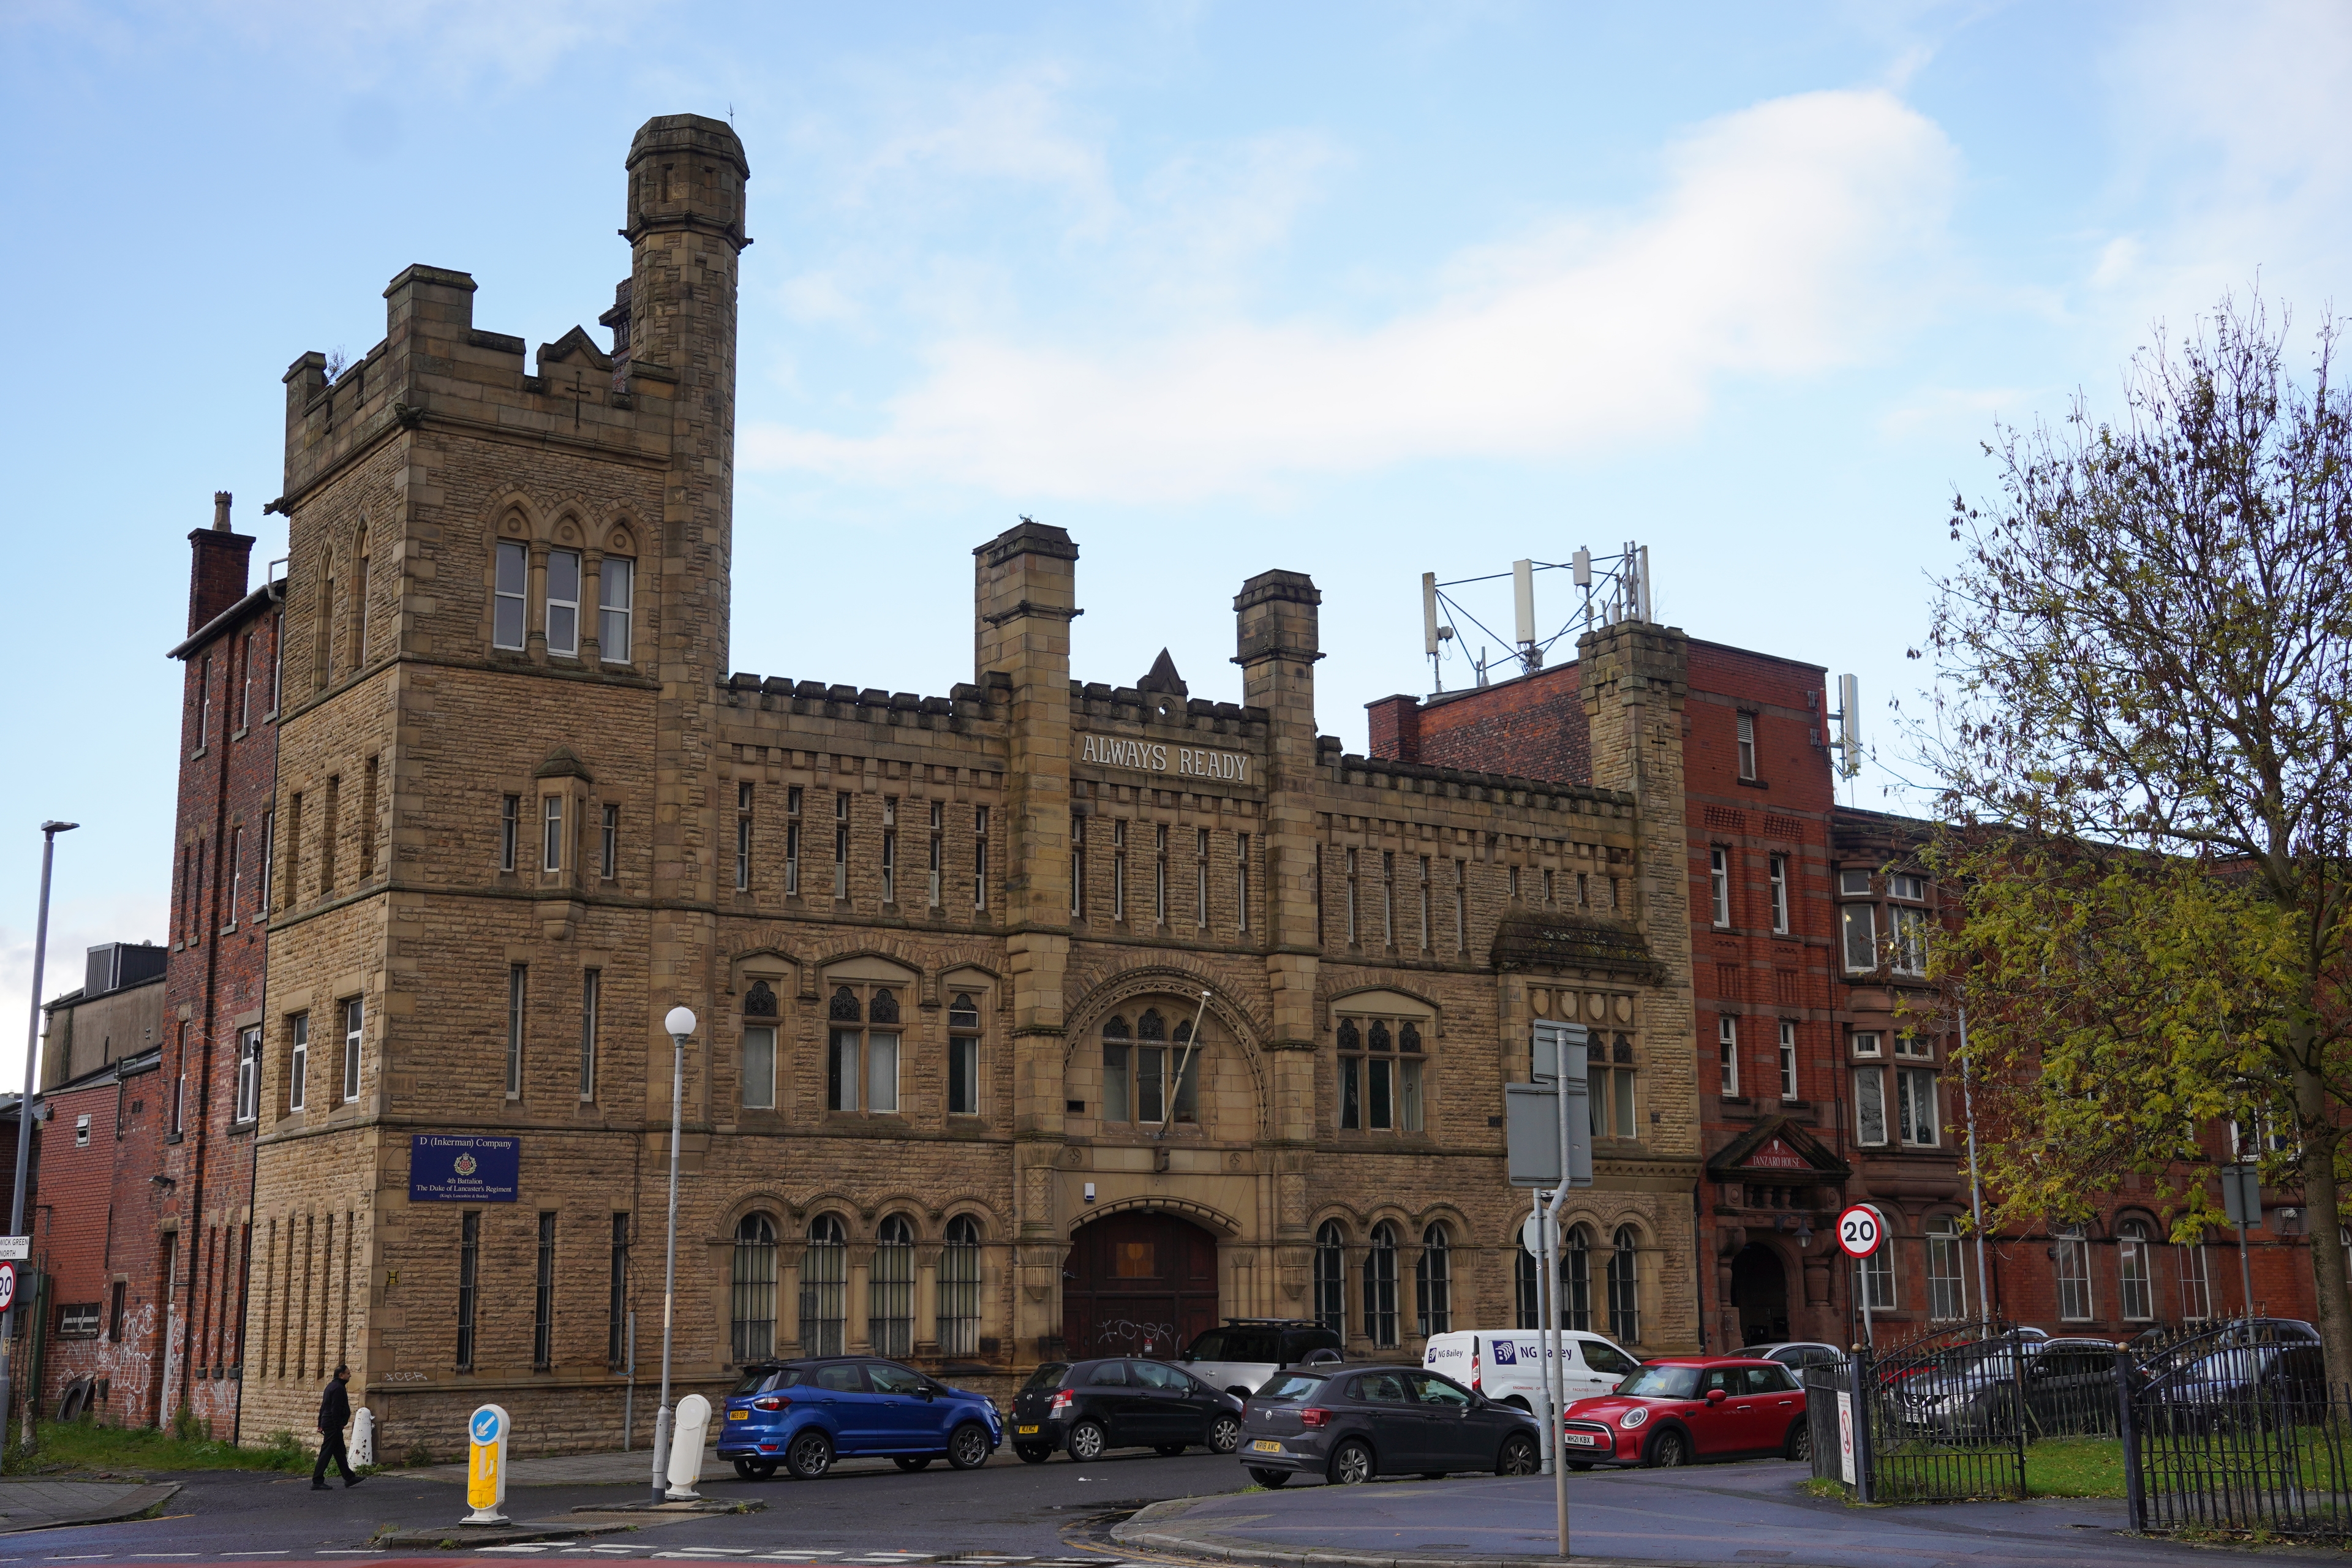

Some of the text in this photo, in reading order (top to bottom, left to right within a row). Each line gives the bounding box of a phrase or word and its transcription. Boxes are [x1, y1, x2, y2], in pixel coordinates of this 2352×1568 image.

[1082, 735, 1247, 781] ALWAYS READY
[431, 1137, 474, 1148] (Inkerman)
[476, 1139, 512, 1149] Company
[1752, 1156, 1800, 1167] TANZARO HOUSE
[1844, 1221, 1874, 1242] 20
[1446, 1349, 1463, 1359] Bailey
[1520, 1346, 1537, 1358] NG
[1256, 1441, 1267, 1450] WR18
